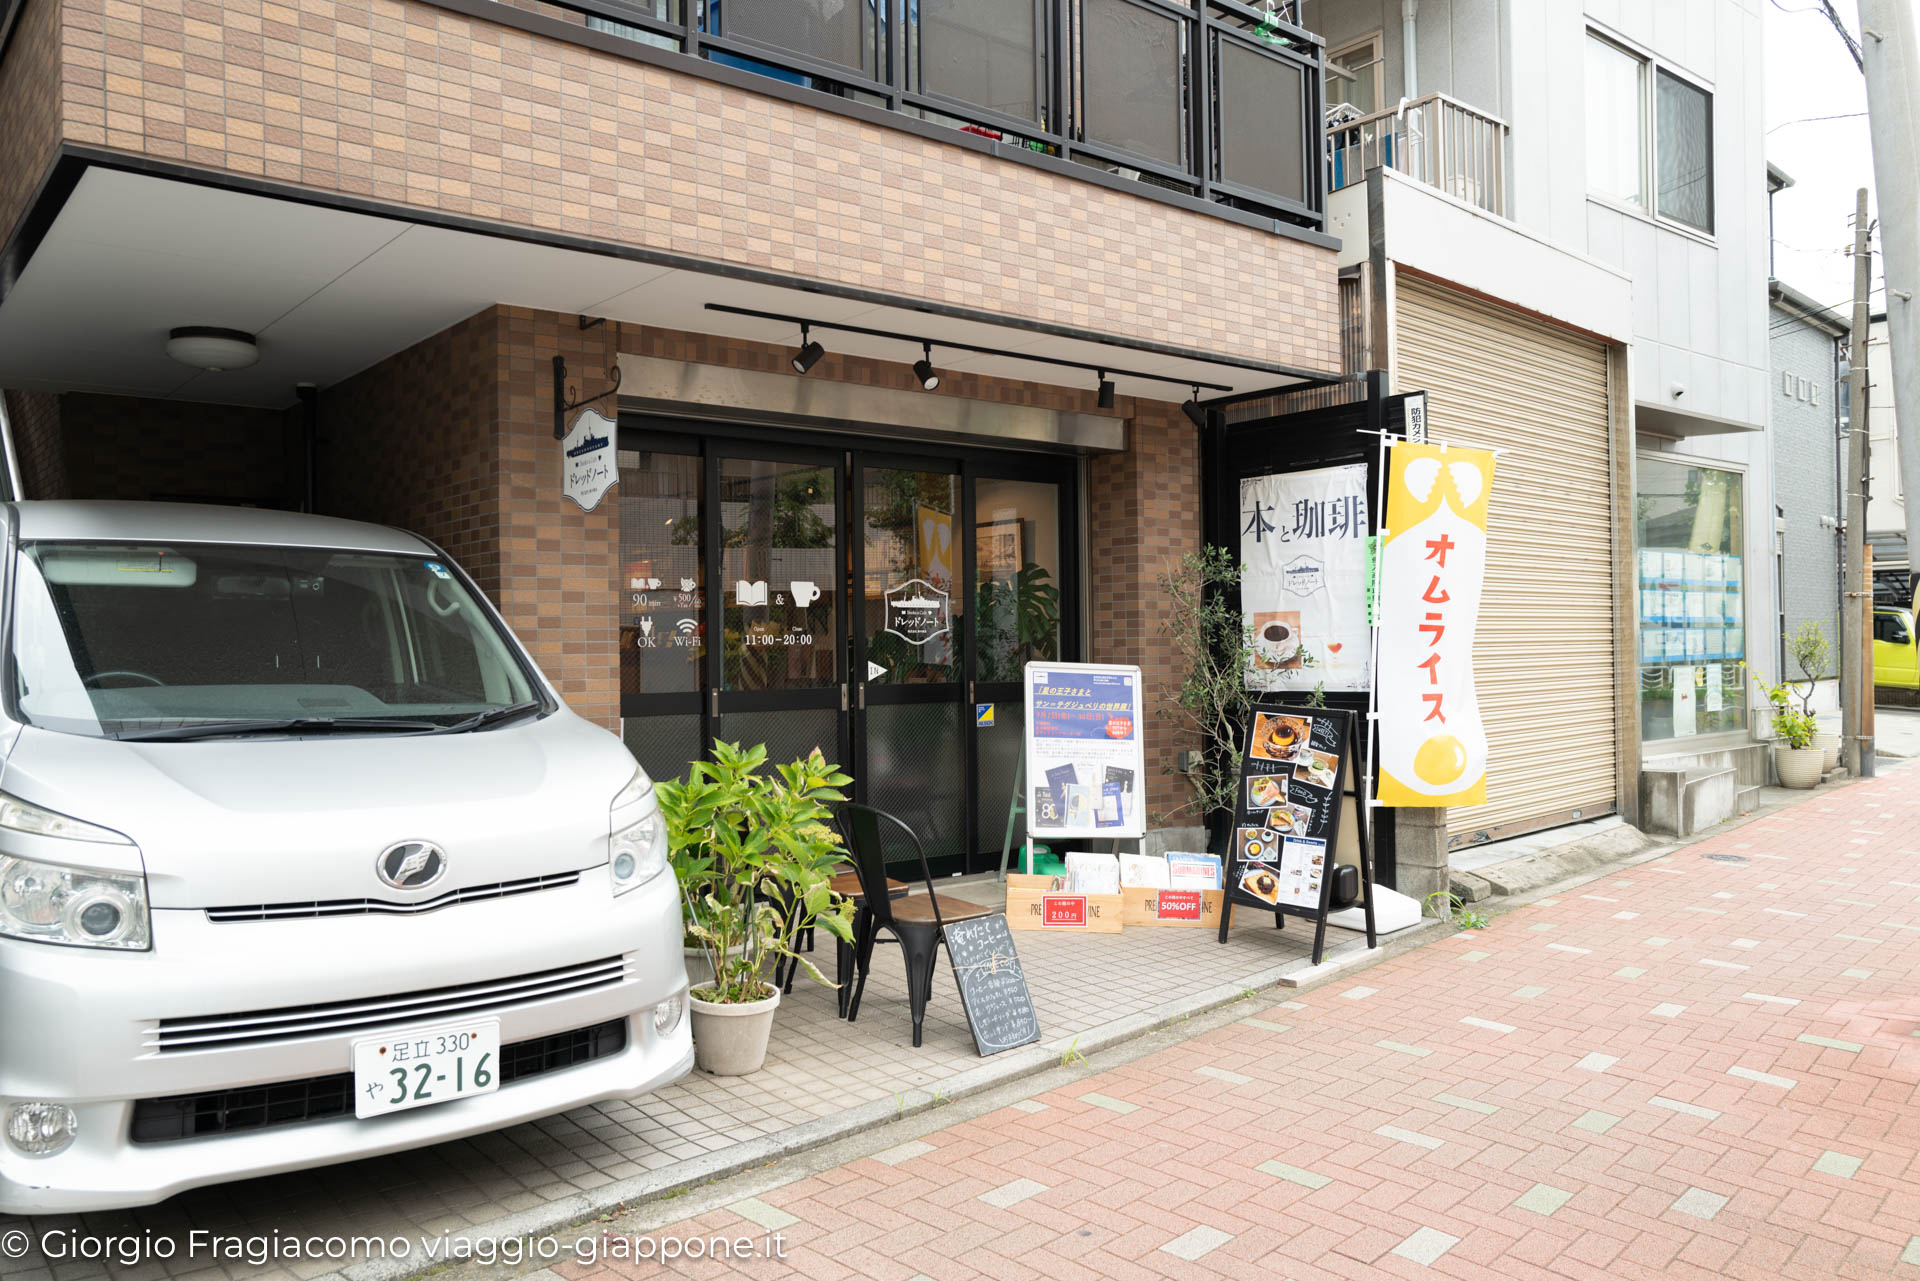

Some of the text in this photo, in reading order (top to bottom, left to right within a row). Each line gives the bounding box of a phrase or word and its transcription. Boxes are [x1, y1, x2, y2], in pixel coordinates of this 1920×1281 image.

[569, 464, 609, 489] ドレッドノート
[1241, 495, 1366, 543] 本と珈琲
[632, 593, 647, 606] 90
[775, 594, 785, 605] &
[894, 616, 940, 628] ドレッドノート
[1417, 533, 1455, 725] オムライス
[637, 636, 656, 648] OK
[674, 636, 701, 646] Wi-Fi
[1171, 862, 1216, 877] SUBMARINES
[1161, 901, 1197, 912] 50%OFF
[1052, 911, 1077, 920] 200円
[391, 1032, 470, 1062] 足立 330
[365, 1052, 491, 1104] や 32-16
